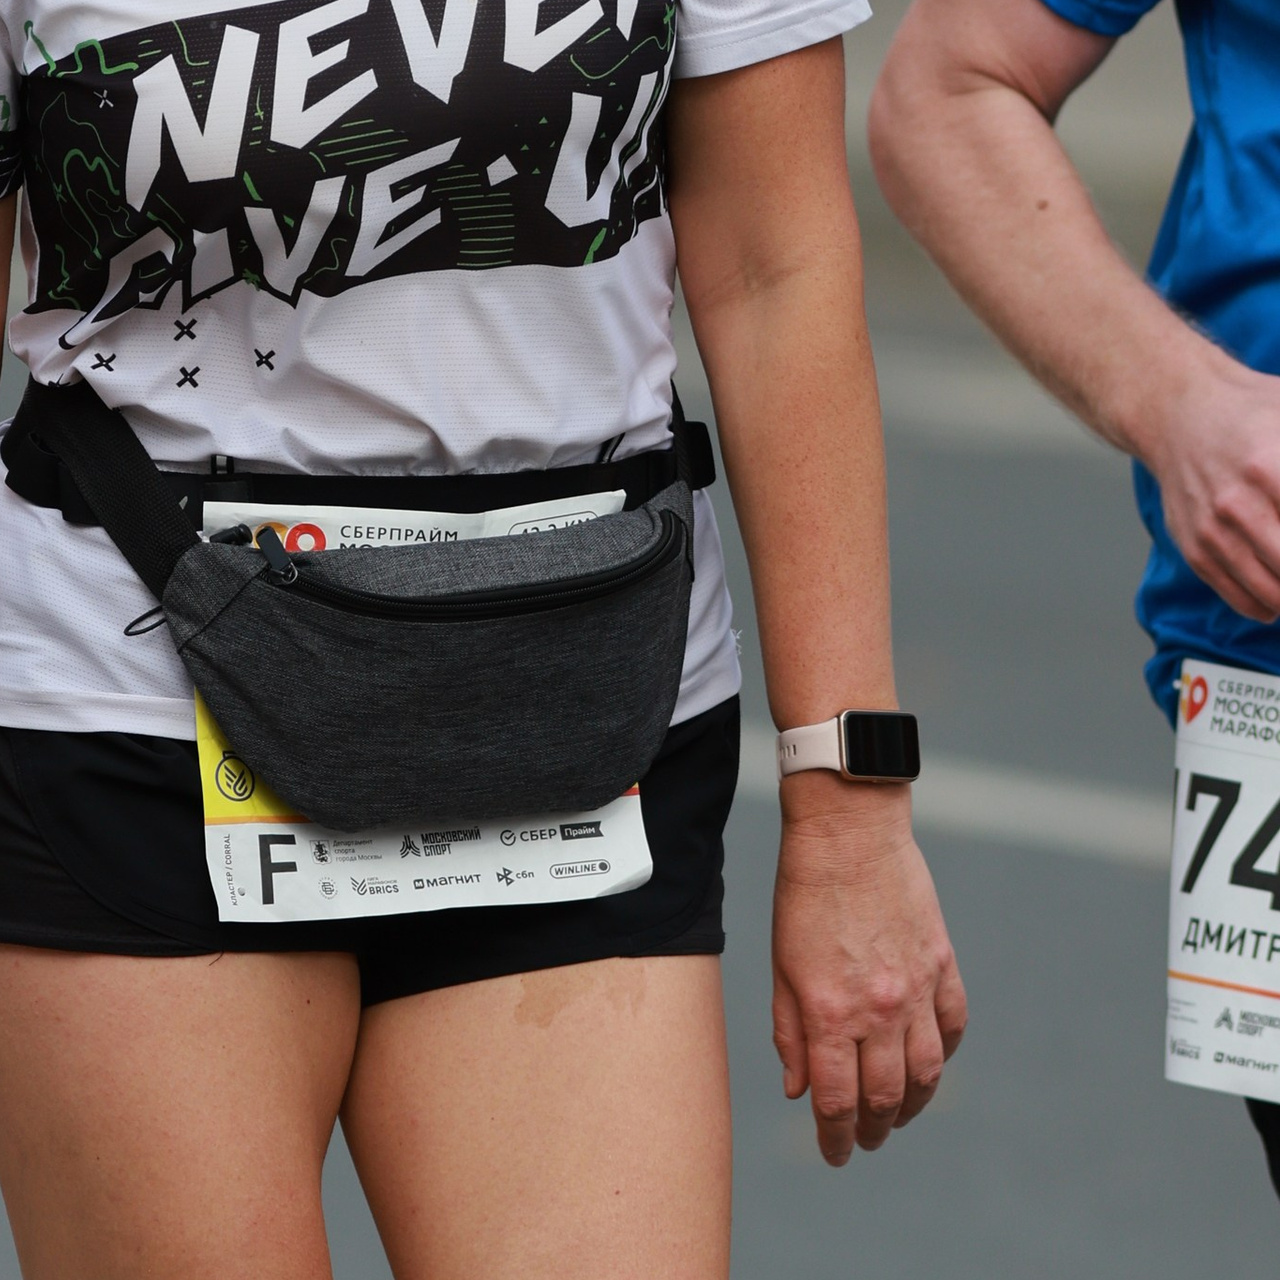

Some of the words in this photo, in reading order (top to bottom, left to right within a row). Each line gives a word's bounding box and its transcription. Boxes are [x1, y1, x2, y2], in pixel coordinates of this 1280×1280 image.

[339, 524, 459, 542] СБЕРПРАЙМ
[421, 826, 482, 845] МОСКОВСКИЙ
[520, 828, 557, 842] СБЕР
[564, 825, 596, 837] Прайм
[223, 833, 232, 866] CORRAL
[423, 843, 453, 857] СПОРТ
[258, 833, 298, 906] F
[554, 863, 597, 876] WINLINE
[225, 871, 238, 906] КЛАСТЕР
[369, 884, 400, 895] BRICS
